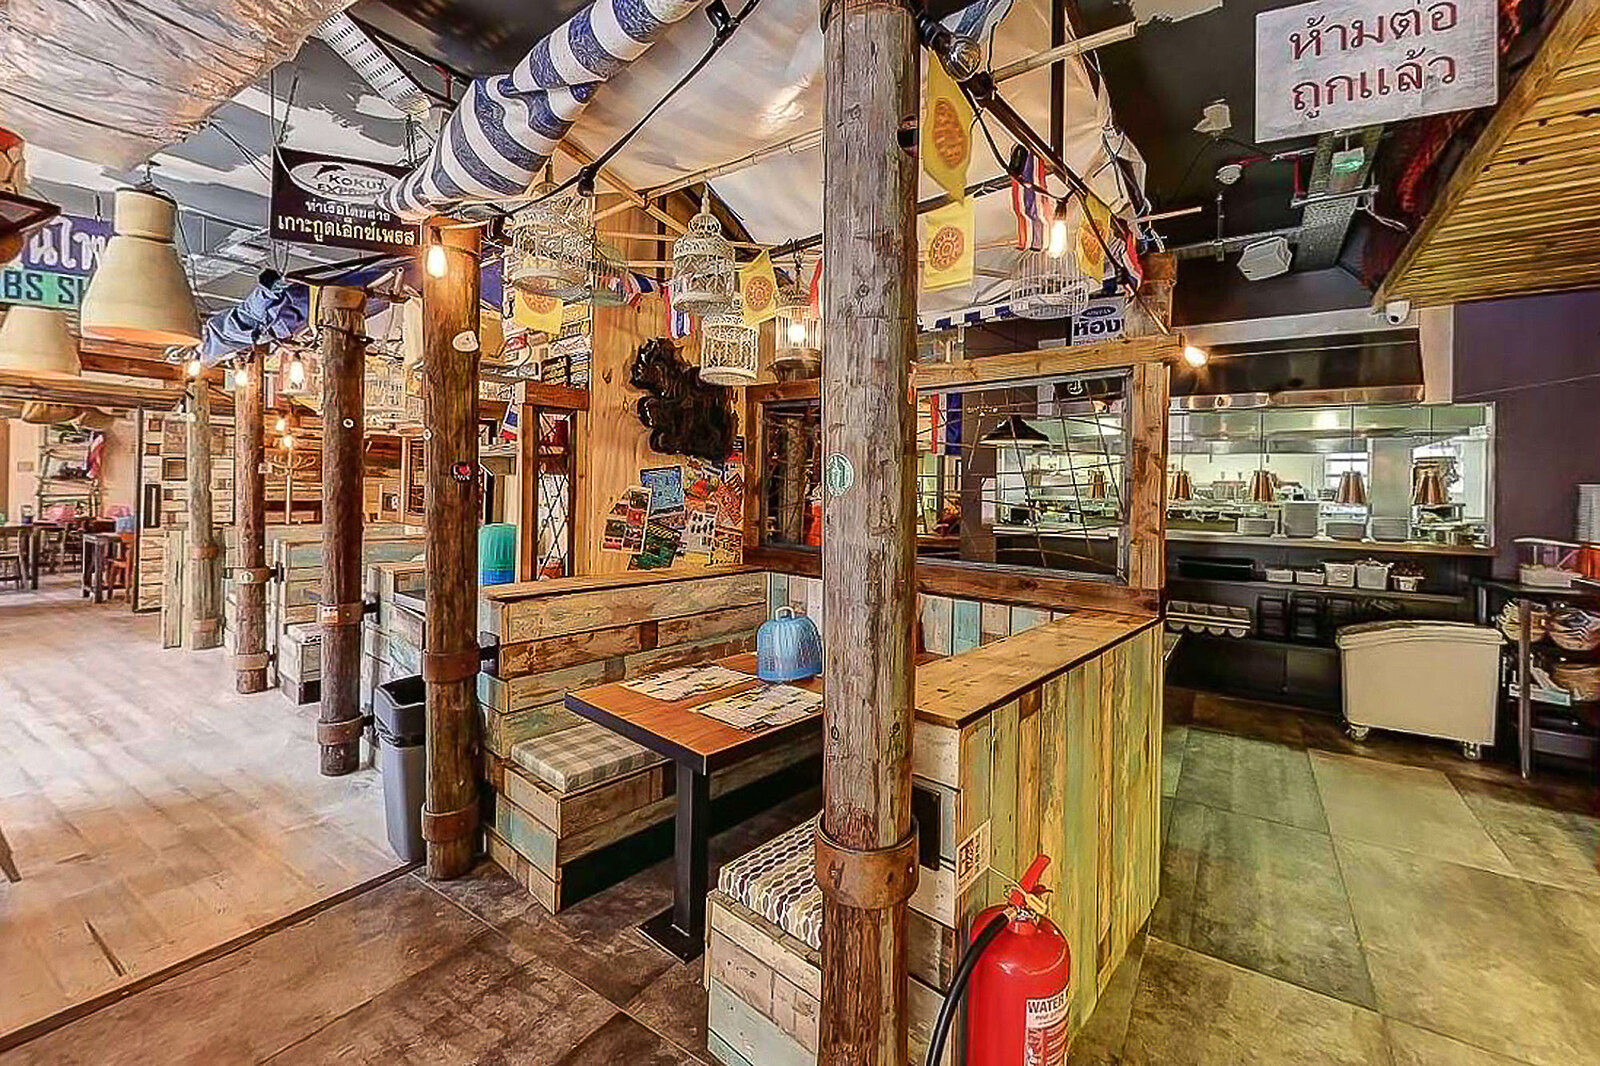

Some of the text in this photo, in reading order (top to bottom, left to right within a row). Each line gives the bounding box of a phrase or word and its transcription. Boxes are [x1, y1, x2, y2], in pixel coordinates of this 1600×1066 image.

[1289, 0, 1458, 60] ห้ามต่อ
[1291, 47, 1457, 119] ถูกแล้ว
[1027, 993, 1065, 1014] WATER
